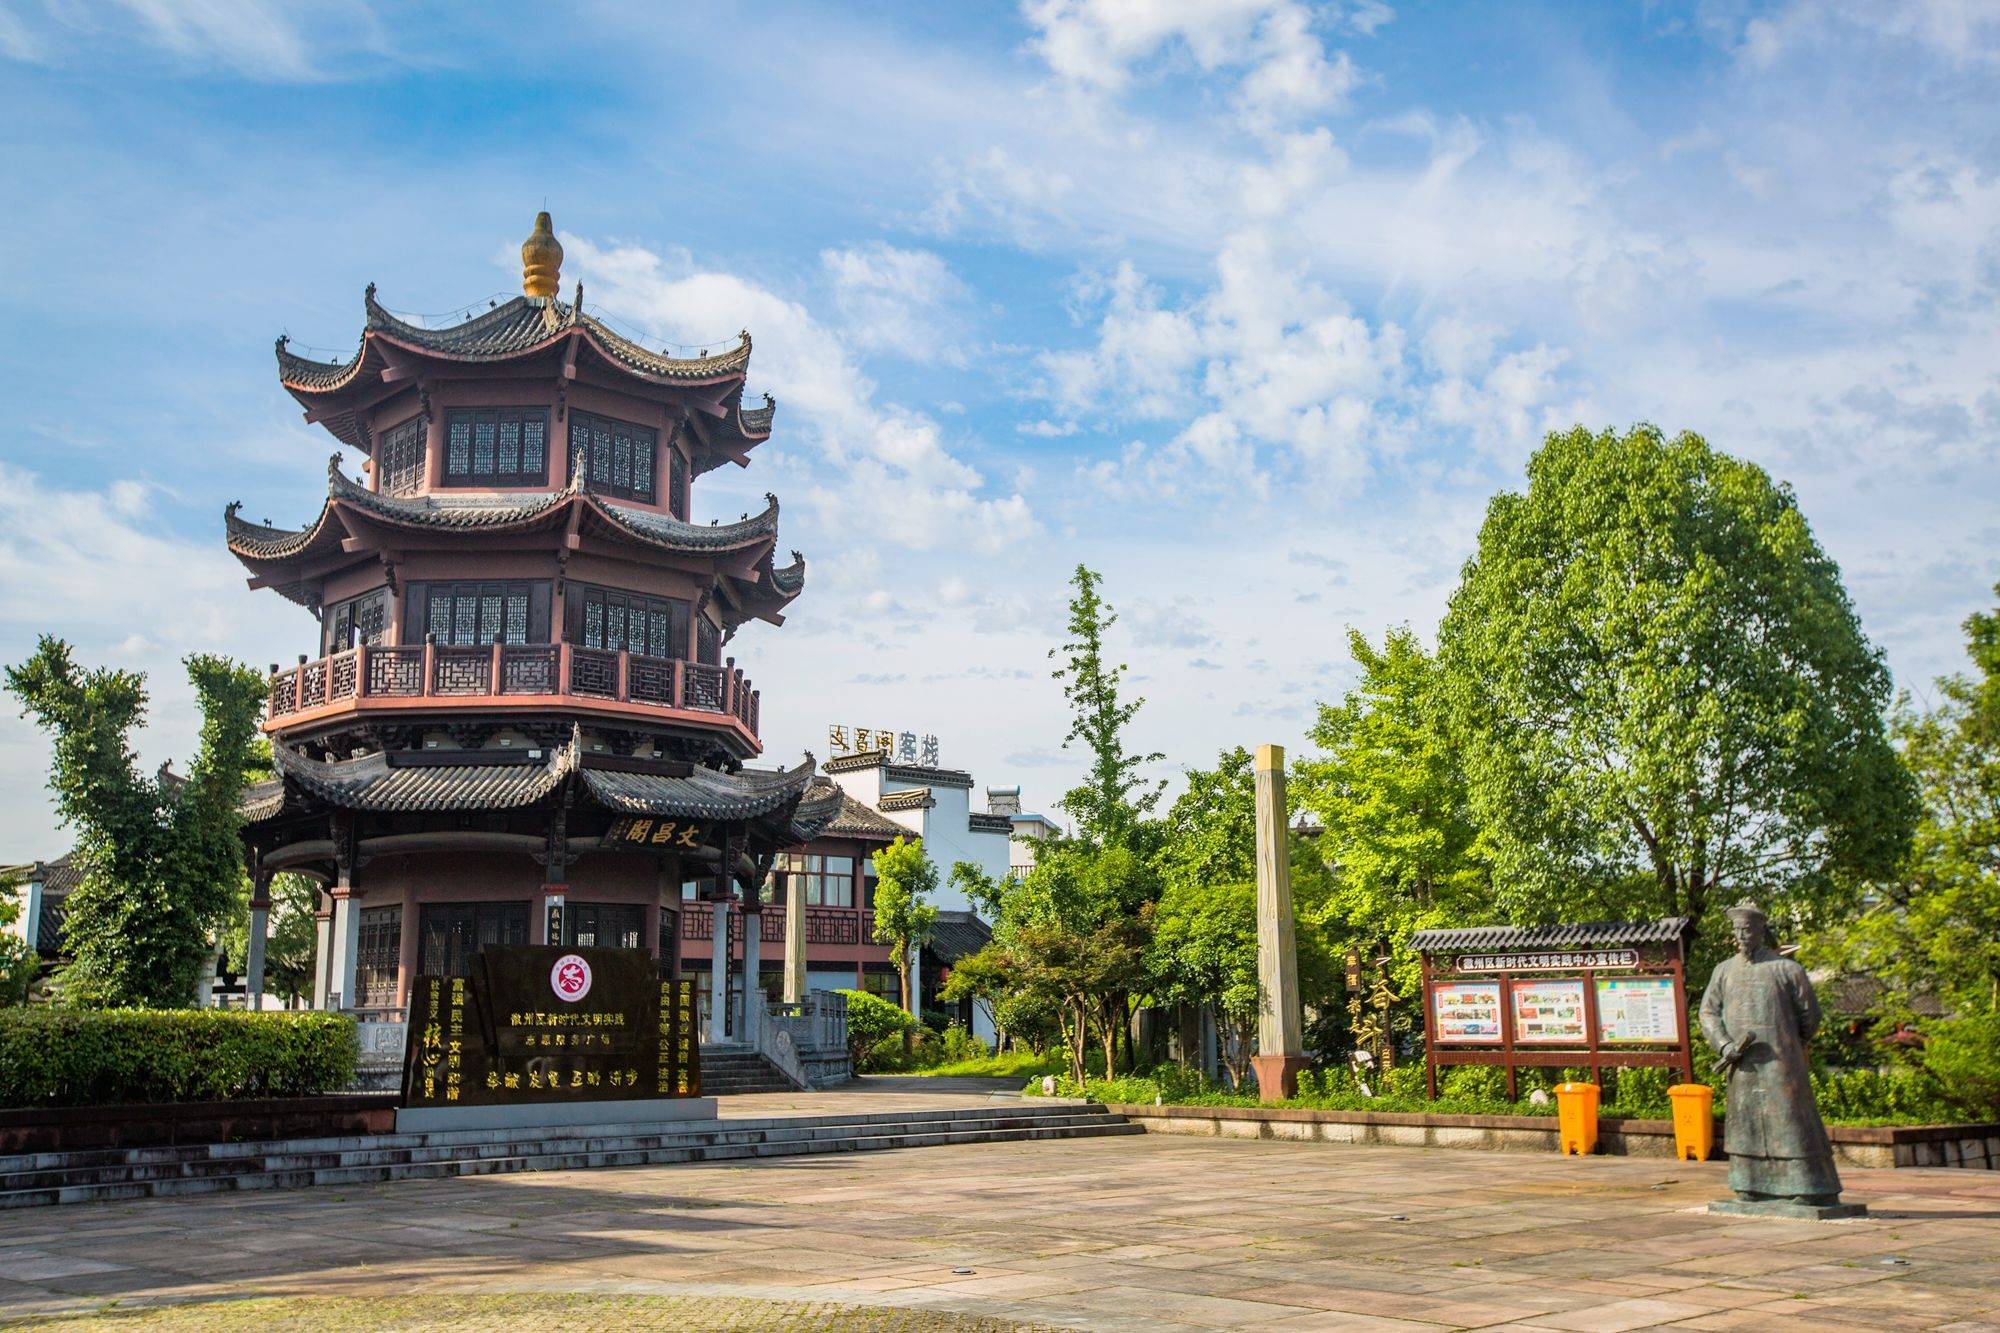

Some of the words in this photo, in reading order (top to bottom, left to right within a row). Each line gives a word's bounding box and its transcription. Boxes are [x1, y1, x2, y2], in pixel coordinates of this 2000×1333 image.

[1462, 952, 1633, 970] 徽州区新时代文明实践中心宣传栏
